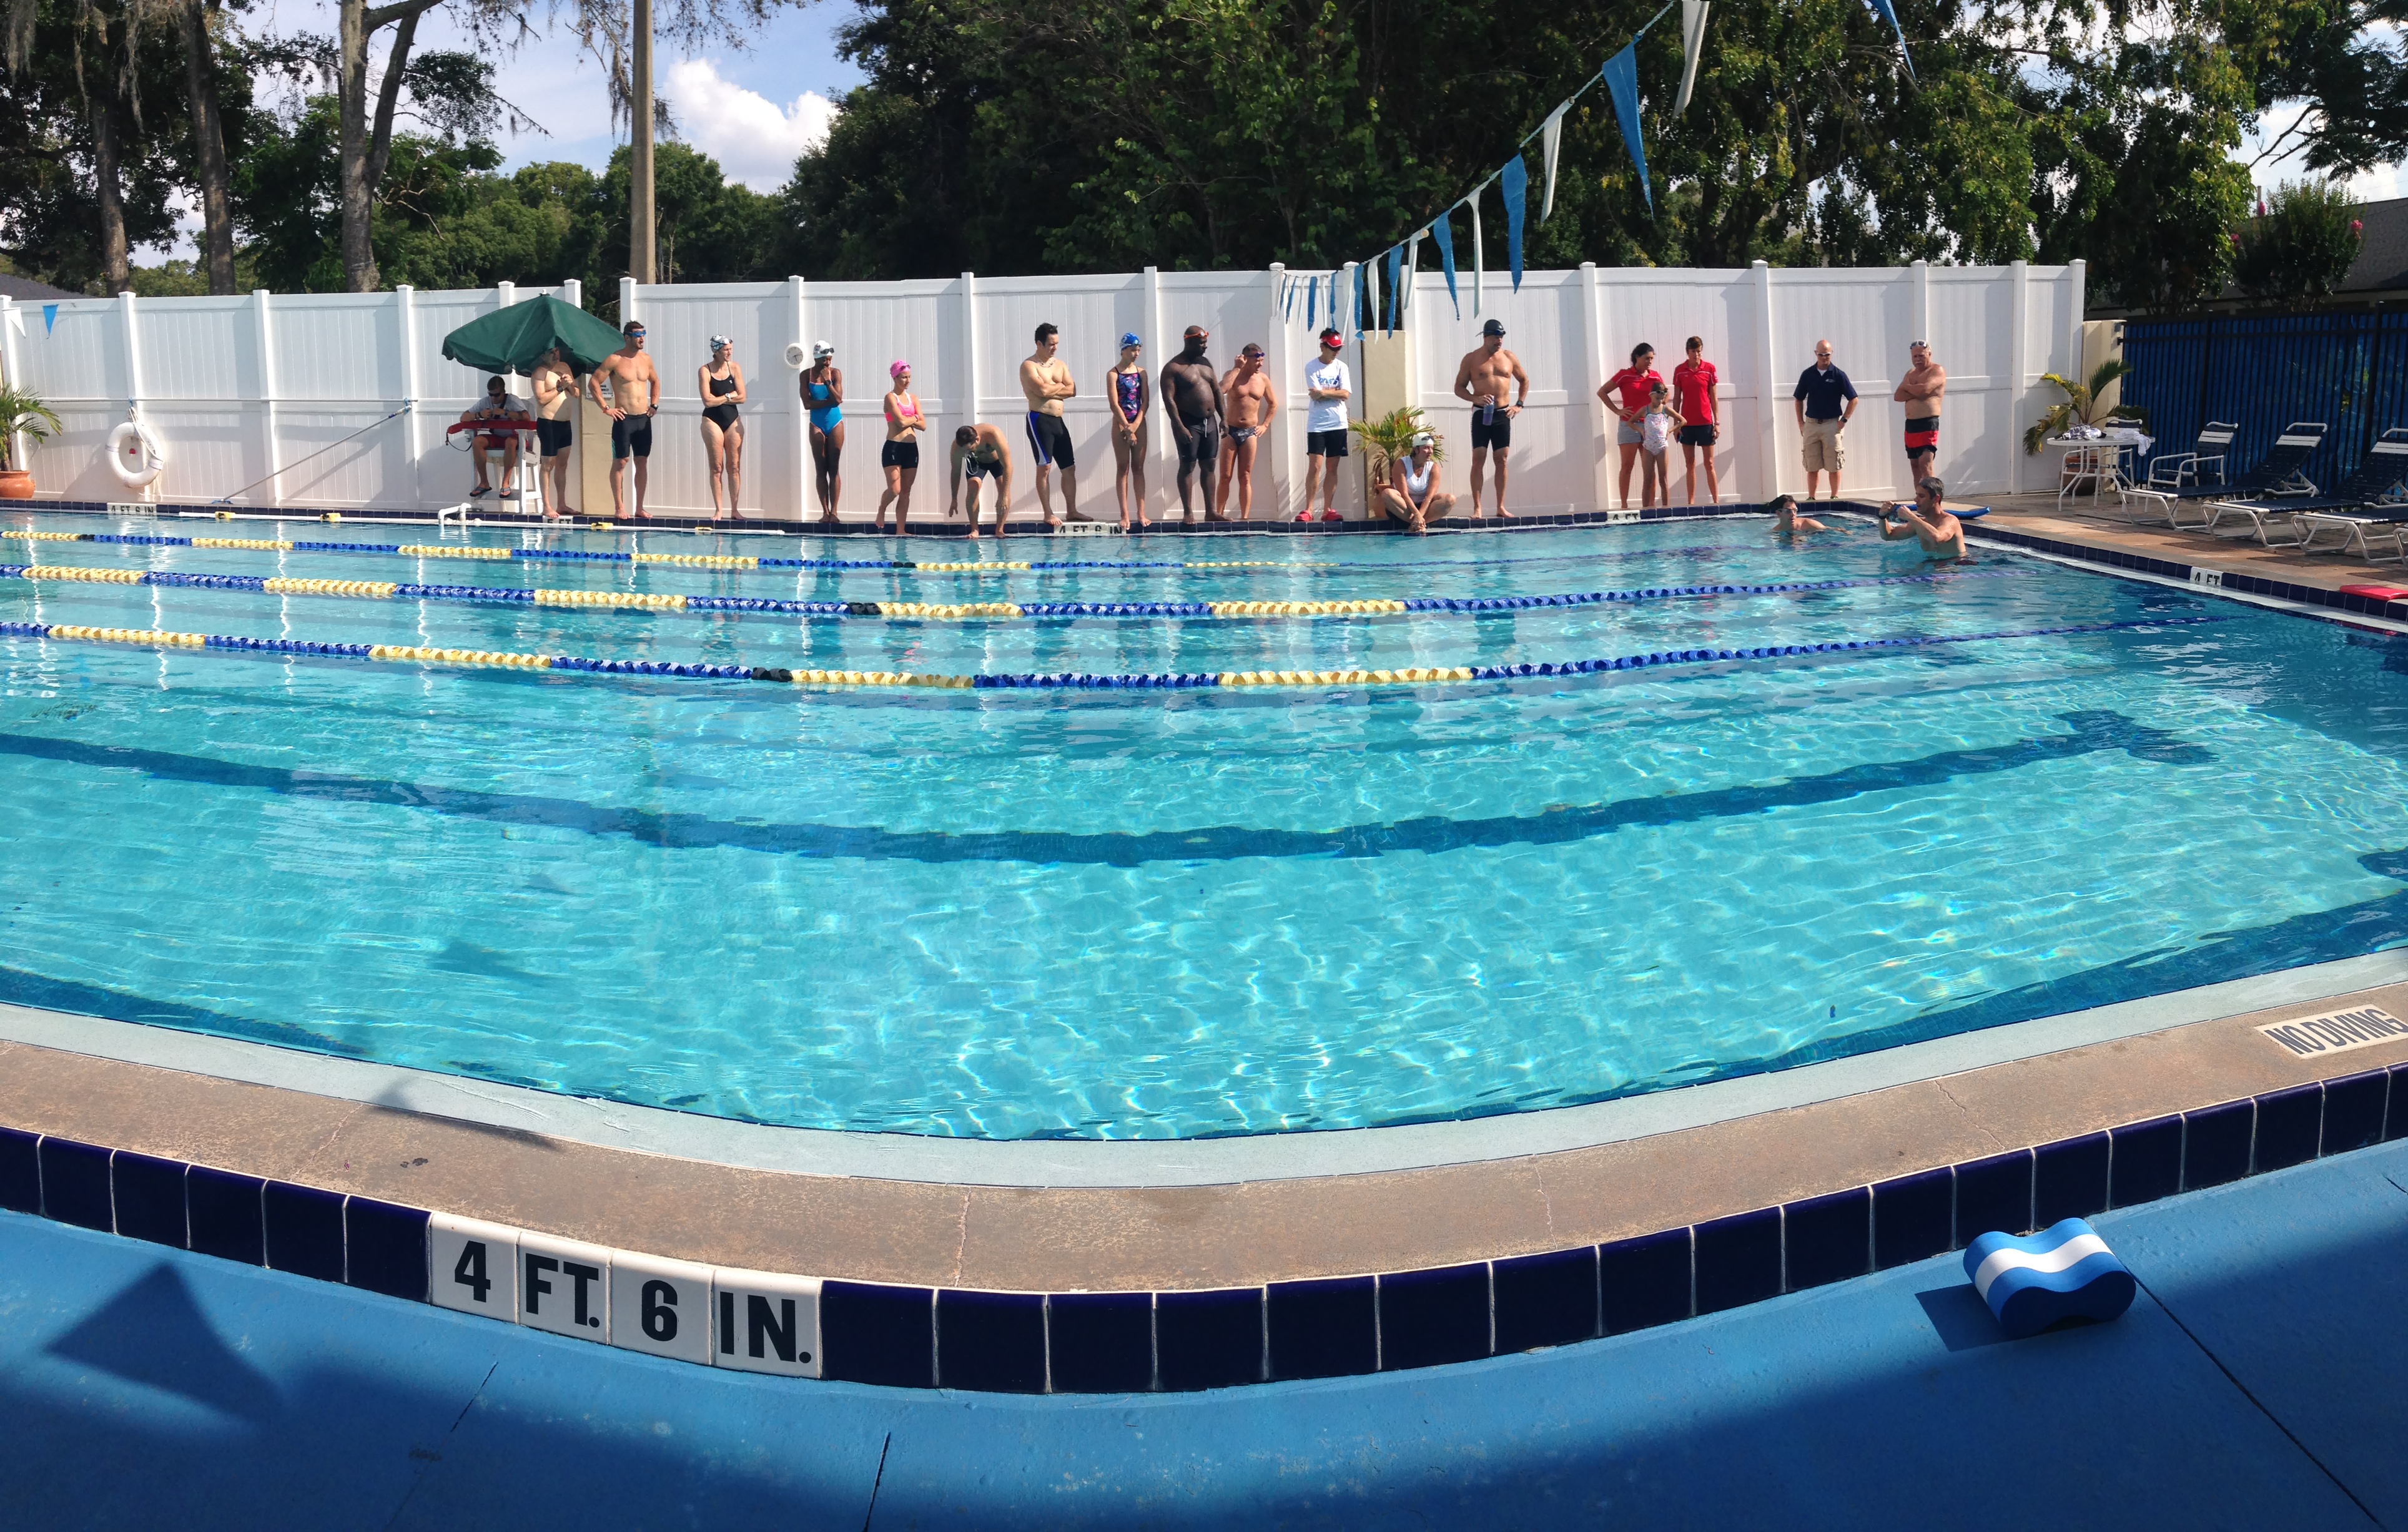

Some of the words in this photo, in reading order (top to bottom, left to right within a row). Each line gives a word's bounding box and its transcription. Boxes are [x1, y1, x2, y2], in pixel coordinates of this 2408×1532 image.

[1110, 526, 1122, 534] IN
[2206, 574, 2220, 585] FT
[2264, 1025, 2326, 1054] NO
[2300, 1009, 2408, 1047] DIVING
[454, 1240, 491, 1304] 4
[525, 1253, 600, 1328] FT.
[641, 1279, 678, 1342] 6
[719, 1291, 812, 1364] IN.
